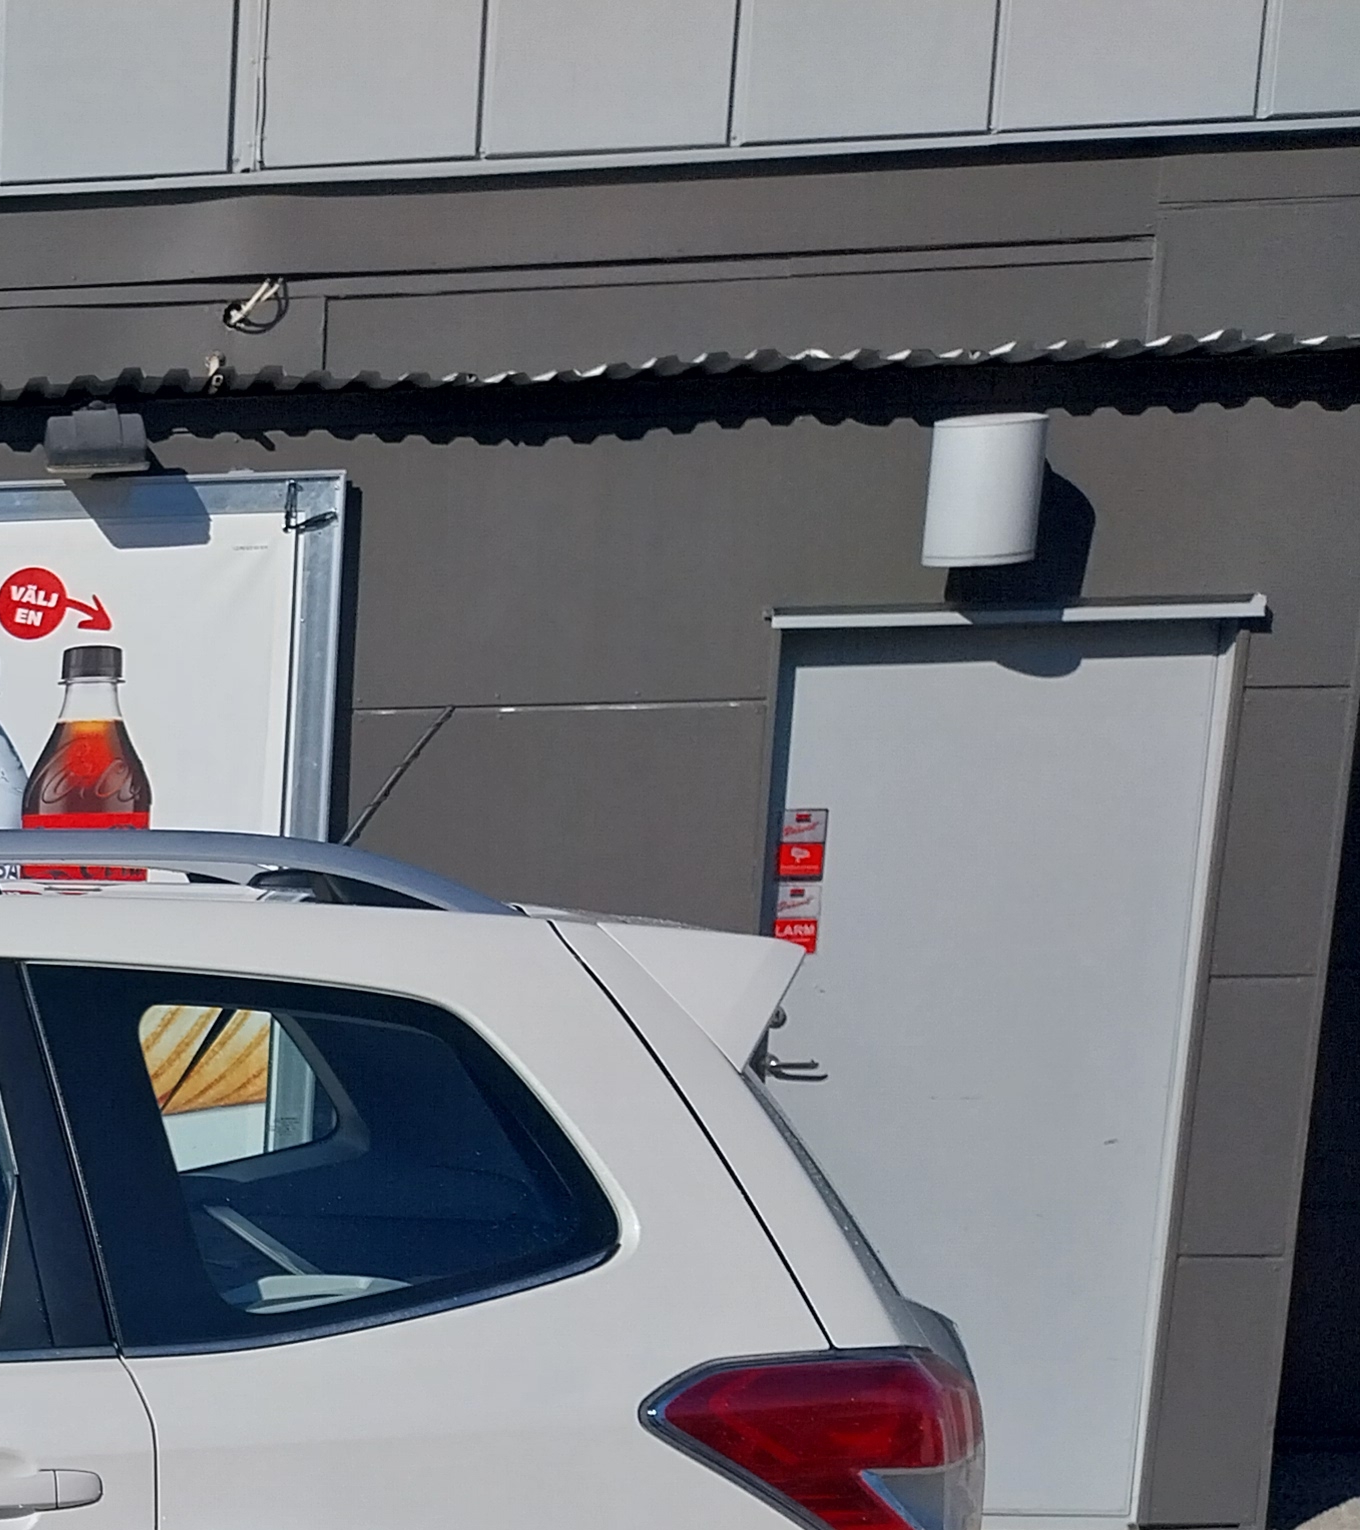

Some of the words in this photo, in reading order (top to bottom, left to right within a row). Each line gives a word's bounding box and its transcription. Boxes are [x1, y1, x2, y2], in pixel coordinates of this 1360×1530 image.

[9, 585, 59, 609] VÄLJ
[14, 608, 42, 627] EN
[775, 924, 816, 938] LARM
